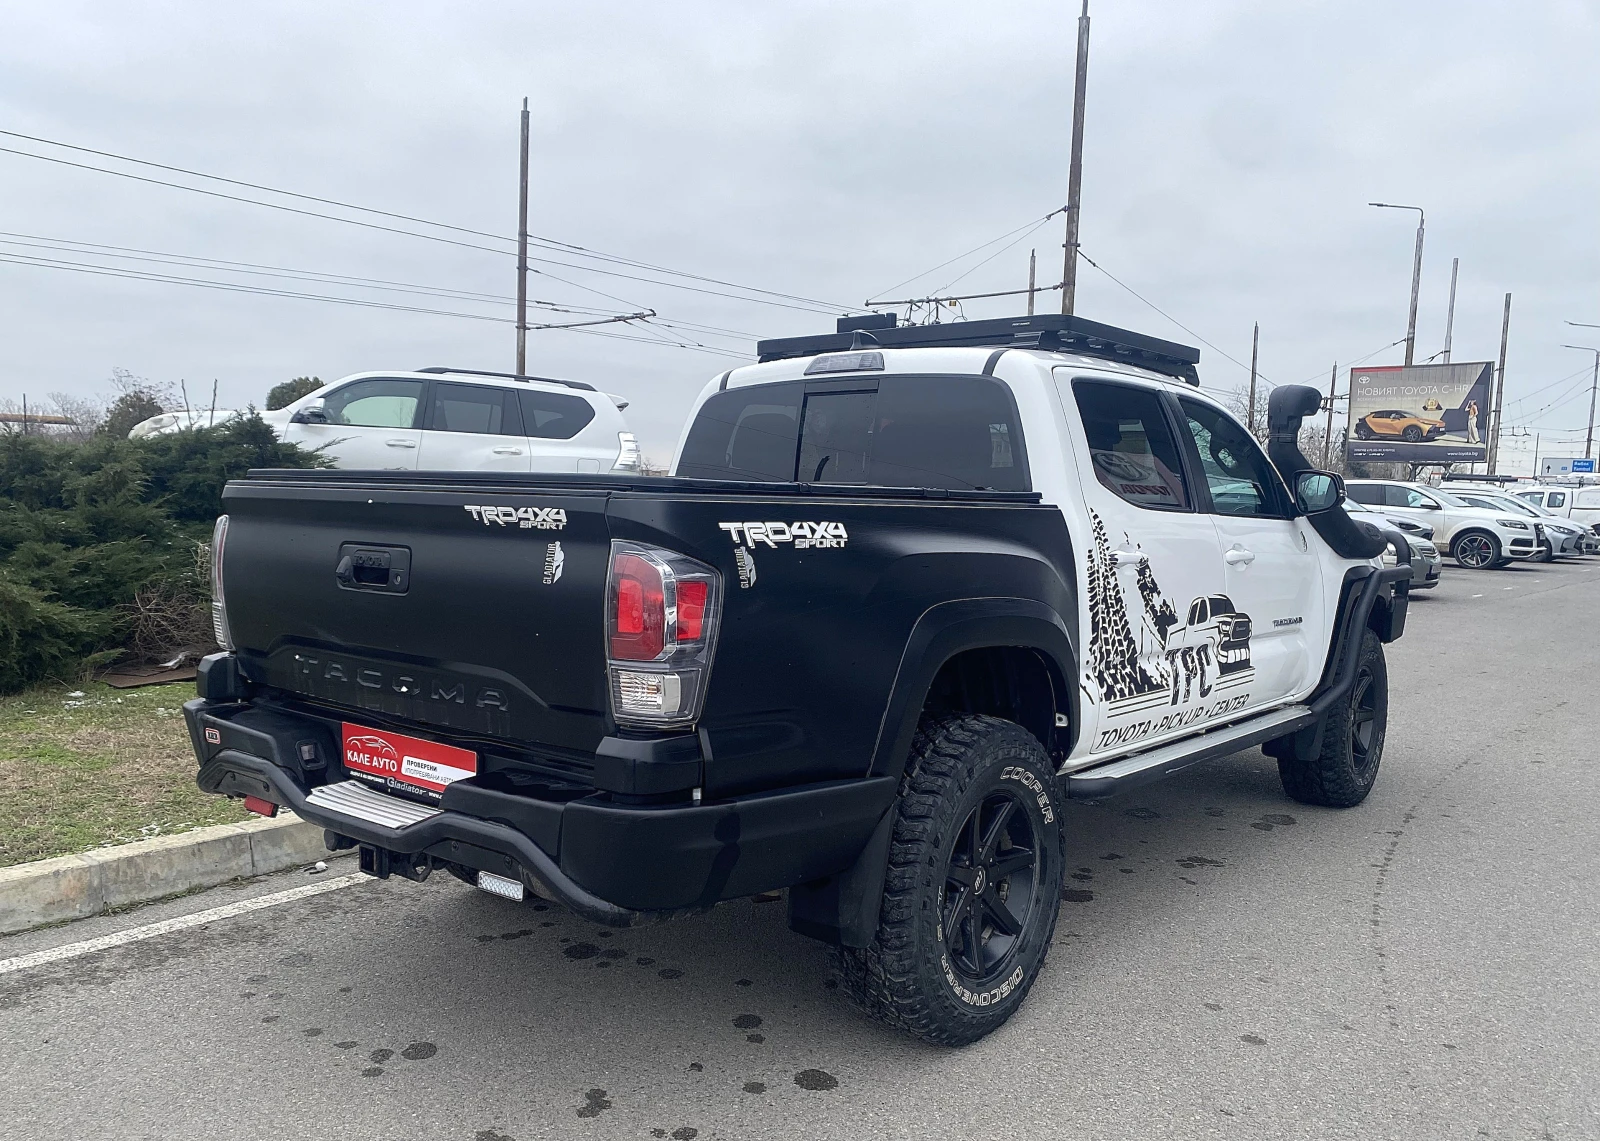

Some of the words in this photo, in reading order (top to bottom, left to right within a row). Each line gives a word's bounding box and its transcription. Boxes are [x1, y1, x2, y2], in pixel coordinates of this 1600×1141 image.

[1357, 386, 1398, 396] НОВИЯТ
[1400, 385, 1439, 395] TOYOTA
[1441, 384, 1469, 394] C-HR
[519, 520, 567, 530] SPORT
[794, 538, 849, 549] SPORT
[542, 543, 556, 585] GLADIATOR
[734, 547, 749, 589] GLADIATOR
[294, 655, 509, 711] TACOMA
[1096, 719, 1152, 749] TOYOTA
[1208, 693, 1250, 718] CENTER
[346, 749, 371, 766] КАЛЕ
[372, 756, 397, 772] АУТО
[406, 759, 438, 772] ПРОВЕРЕНИ
[386, 776, 427, 795] Gladiator
[1000, 766, 1054, 825] COOPER
[941, 953, 1024, 1006] DISCOVERER
